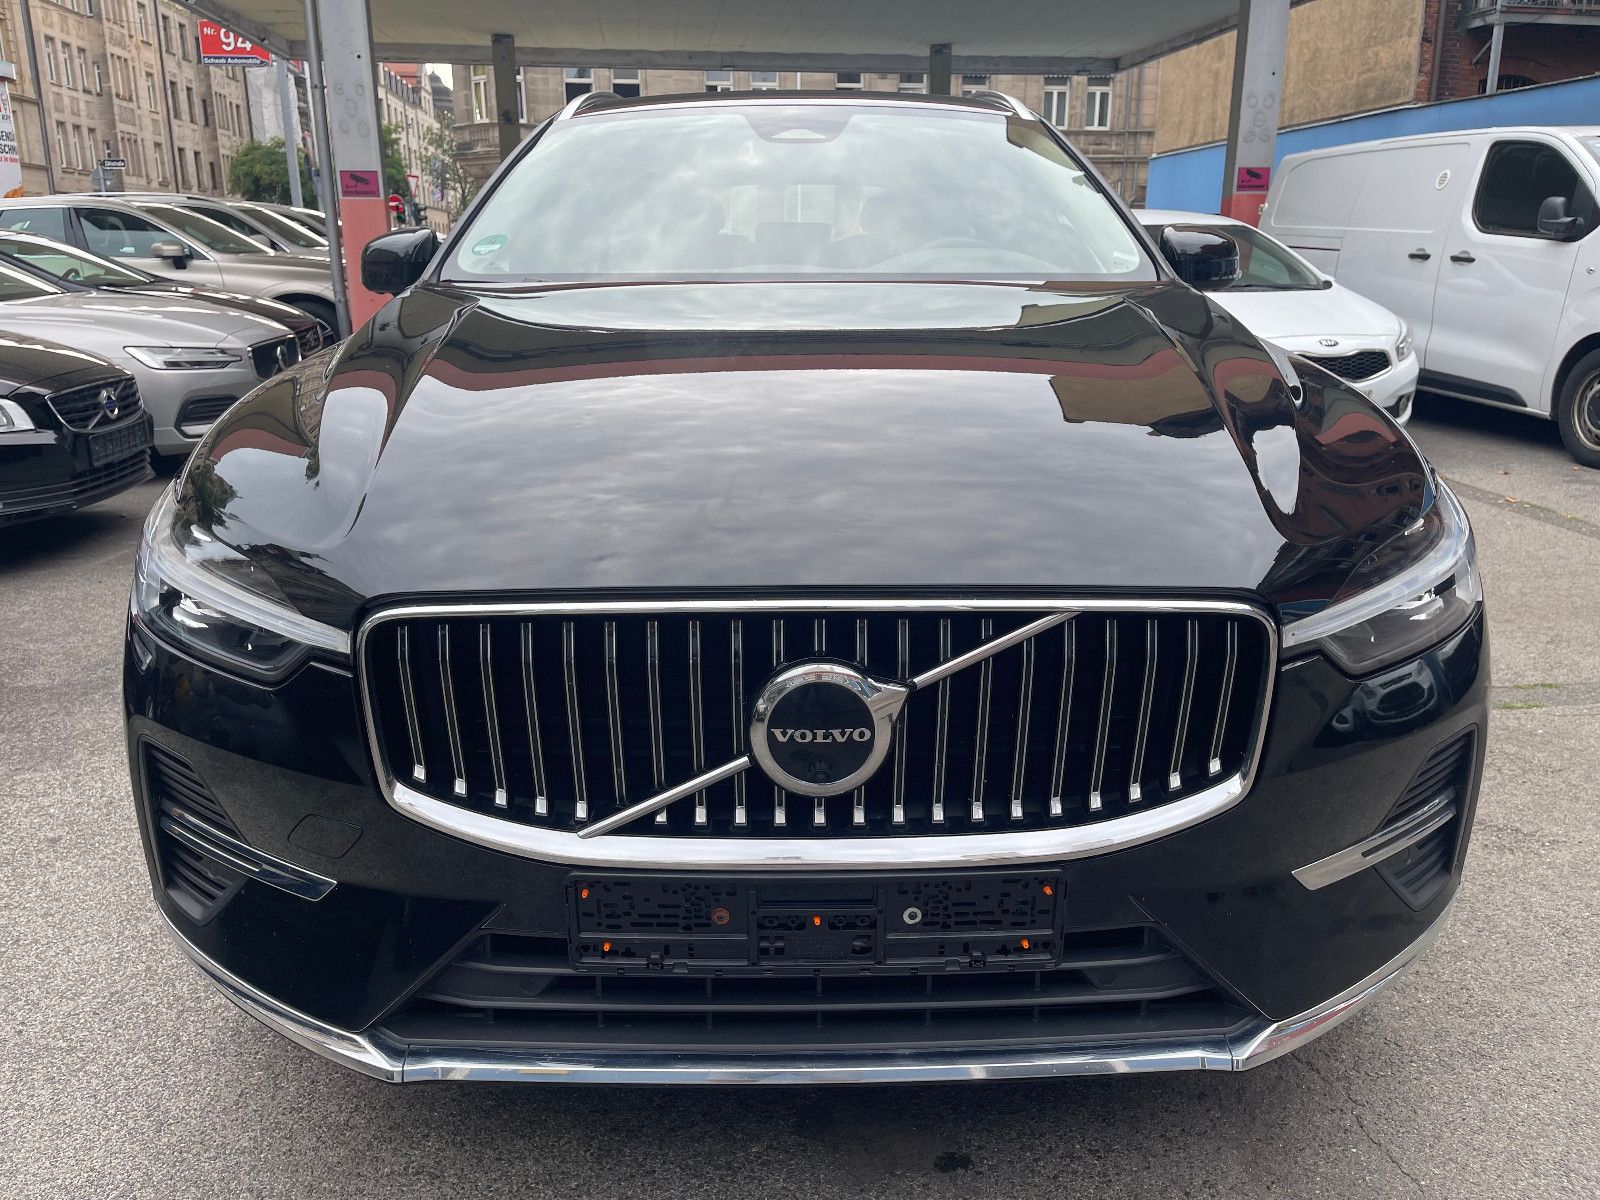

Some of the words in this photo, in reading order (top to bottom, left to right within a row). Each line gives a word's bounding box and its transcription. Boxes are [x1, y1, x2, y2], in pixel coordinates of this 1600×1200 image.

[203, 26, 217, 35] Nr.
[220, 28, 252, 51] 94
[770, 727, 872, 743] VOLVO
